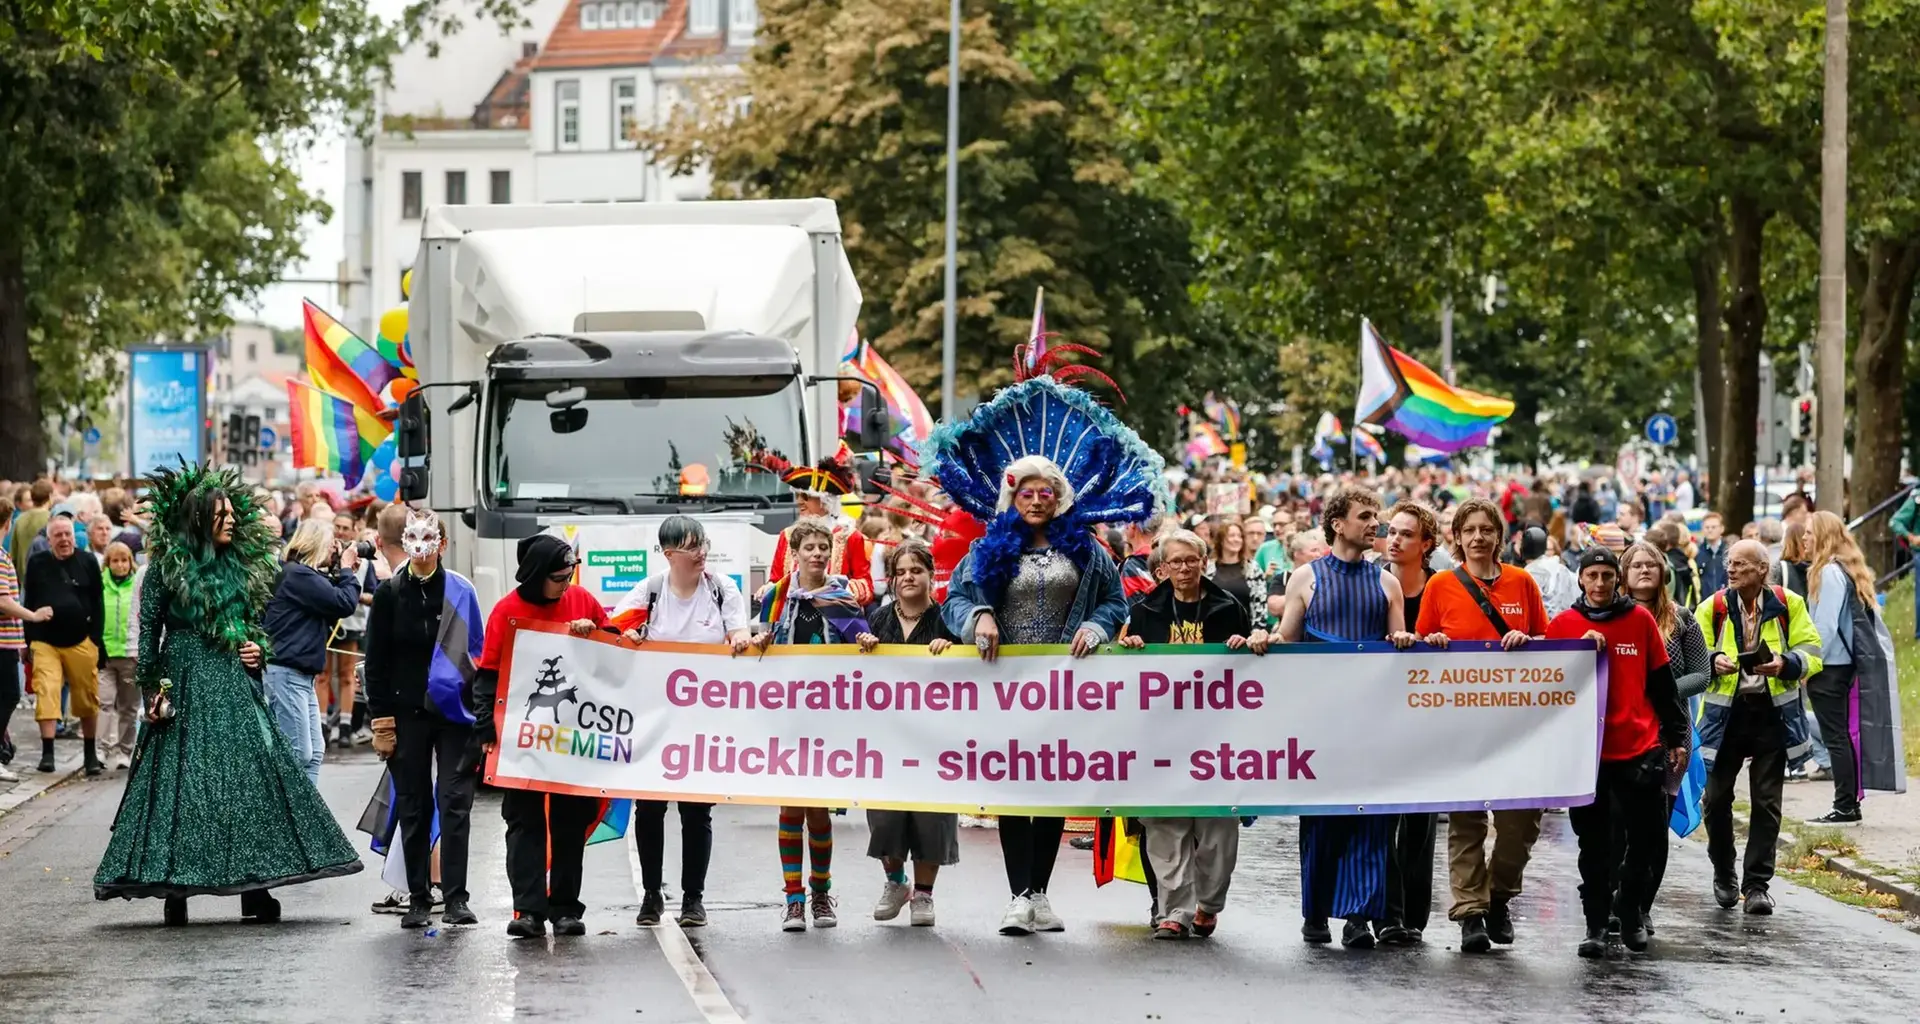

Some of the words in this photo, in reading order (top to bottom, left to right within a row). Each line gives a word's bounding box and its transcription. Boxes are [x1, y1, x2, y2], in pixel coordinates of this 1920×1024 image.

[591, 555, 626, 564] Gruppen
[627, 553, 644, 562] und
[618, 564, 644, 573] Treffs
[605, 580, 638, 588] Beratu
[1500, 607, 1523, 615] TEAM
[1615, 647, 1638, 656] TEAM
[1407, 669, 1435, 685] 22.
[1439, 668, 1516, 684] AUGUST
[1519, 667, 1565, 683] 2026
[665, 668, 978, 711] Generationen
[993, 669, 1124, 711] voller
[1139, 669, 1264, 710] Pride
[1407, 691, 1576, 708] CSD-BREMEN.ORG
[577, 701, 634, 735] CSD
[517, 722, 633, 764] BREMEN
[661, 734, 883, 781] glücklich
[902, 759, 919, 767] -
[937, 739, 1136, 781] sichtbar
[1154, 759, 1171, 767] -
[1189, 737, 1316, 781] stark
